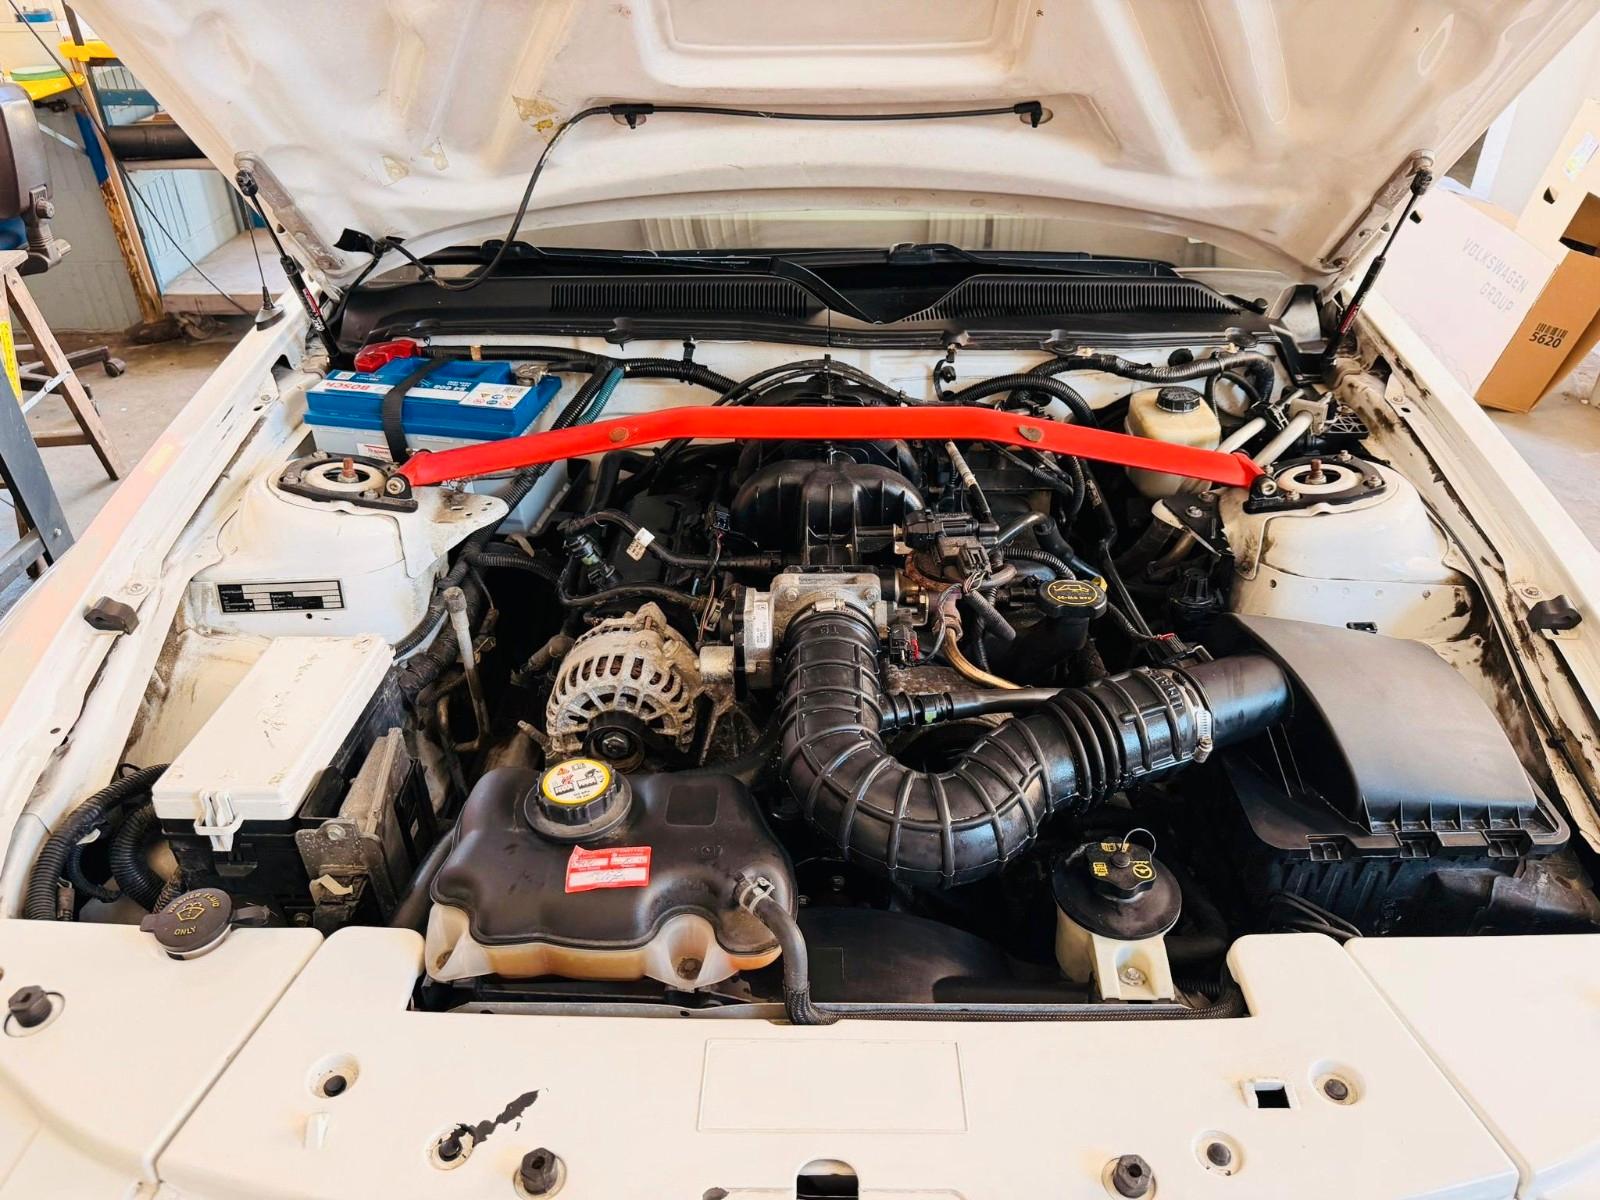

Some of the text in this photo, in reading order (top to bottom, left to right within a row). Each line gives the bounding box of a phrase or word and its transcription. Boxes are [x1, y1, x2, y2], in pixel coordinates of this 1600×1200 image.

[1463, 237, 1529, 293] VOLKSWAGEN
[1480, 282, 1514, 312] GROUP
[1528, 331, 1562, 348] 5620
[325, 382, 371, 391] BOSCH
[174, 925, 197, 936] ONLY
